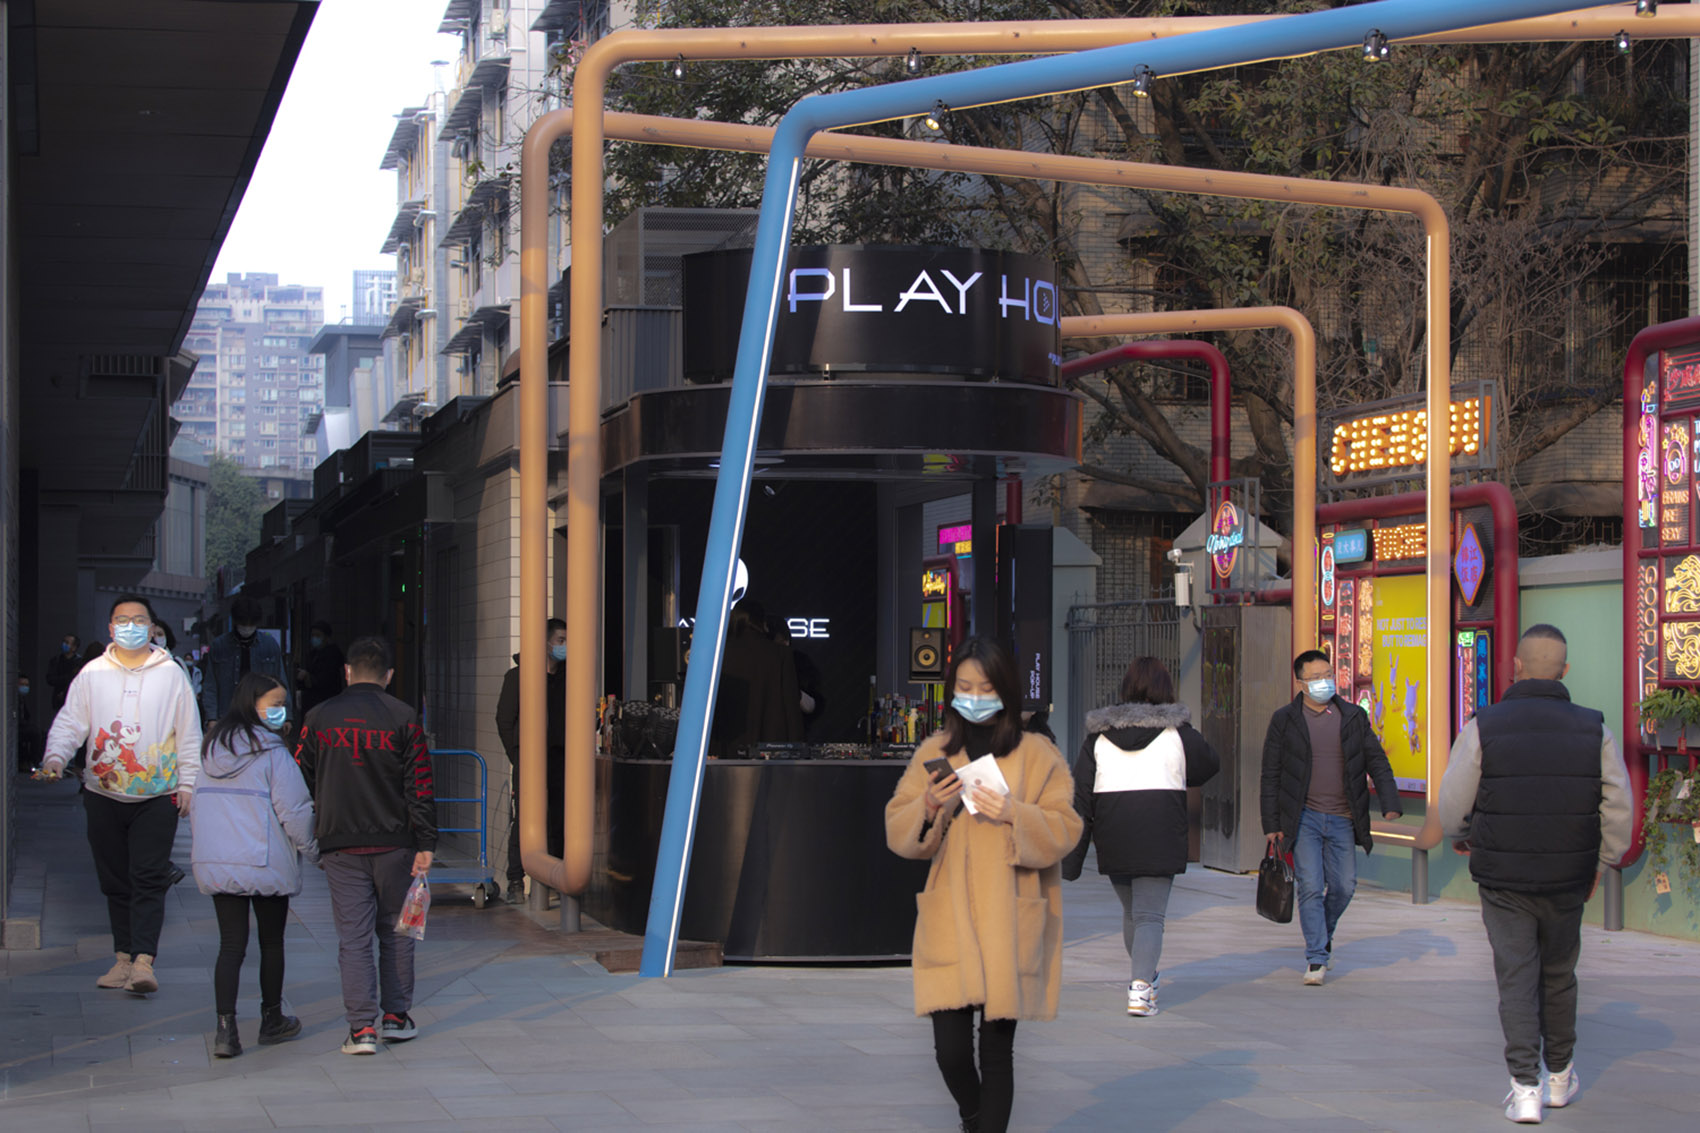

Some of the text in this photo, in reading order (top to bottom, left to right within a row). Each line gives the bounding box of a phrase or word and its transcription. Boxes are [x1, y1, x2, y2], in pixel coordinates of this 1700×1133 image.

[788, 268, 983, 315] PLAY
[1662, 490, 1689, 505] BRAINS
[1662, 508, 1679, 523] ARE
[1662, 527, 1681, 541] SEXY
[1644, 566, 1657, 646] GOOD
